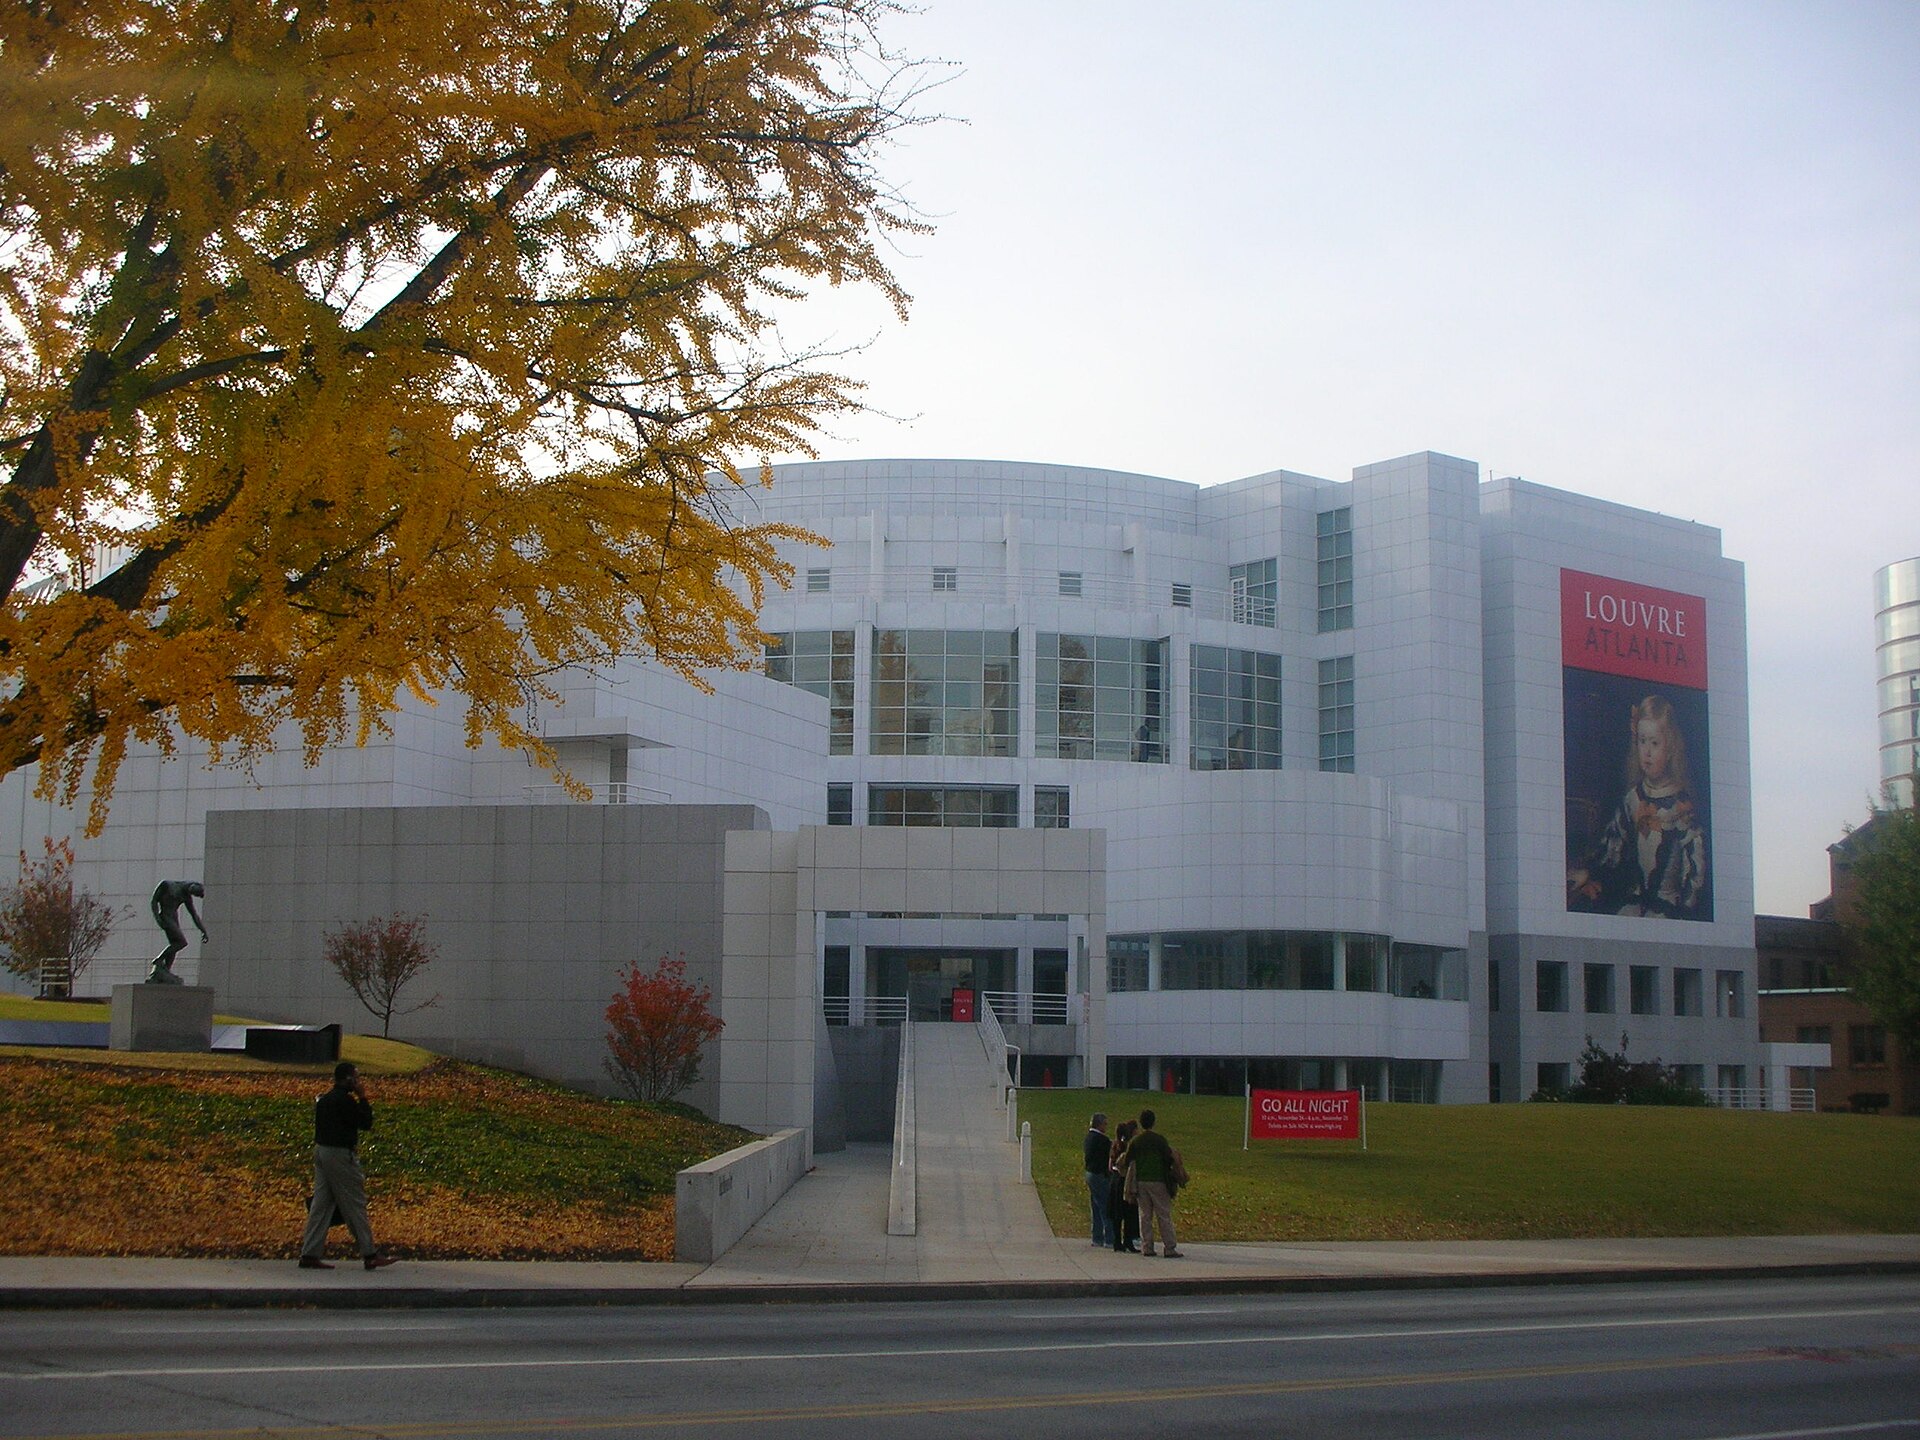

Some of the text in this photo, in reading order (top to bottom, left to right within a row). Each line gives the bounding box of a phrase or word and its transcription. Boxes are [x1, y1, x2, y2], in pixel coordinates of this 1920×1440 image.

[1584, 590, 1686, 637] LOUVRE
[1585, 626, 1687, 666] ATLANTA
[1261, 1098, 1349, 1113] GO ALL NIGHT
